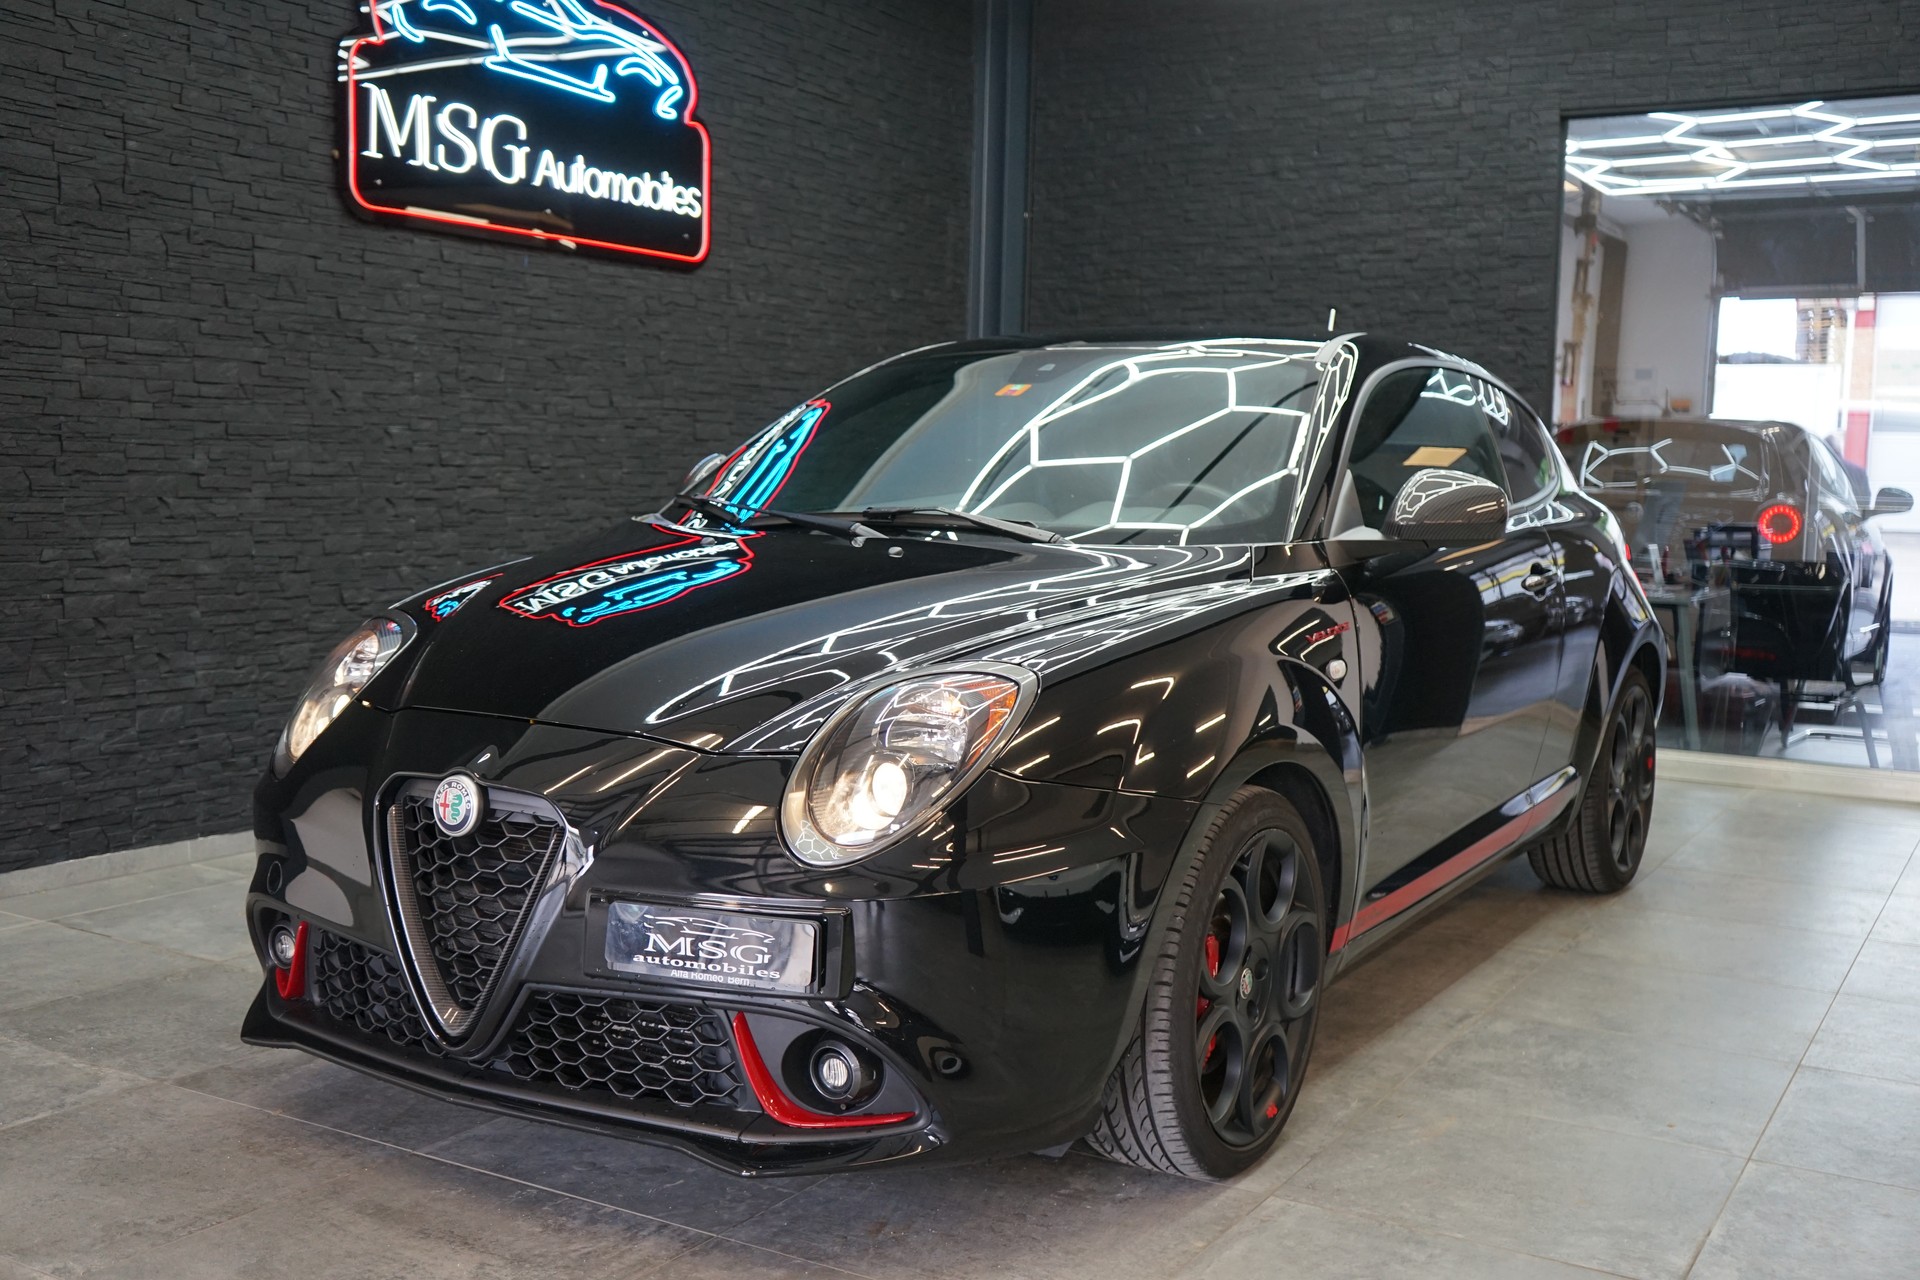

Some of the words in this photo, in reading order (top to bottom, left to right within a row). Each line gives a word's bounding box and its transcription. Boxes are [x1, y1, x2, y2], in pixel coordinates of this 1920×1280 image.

[360, 82, 530, 183] MSG
[532, 149, 701, 218] Automobiles
[435, 783, 449, 804] ALFA
[451, 781, 471, 810] ROMEO
[644, 932, 771, 964] MSG
[633, 953, 780, 979] automobiles
